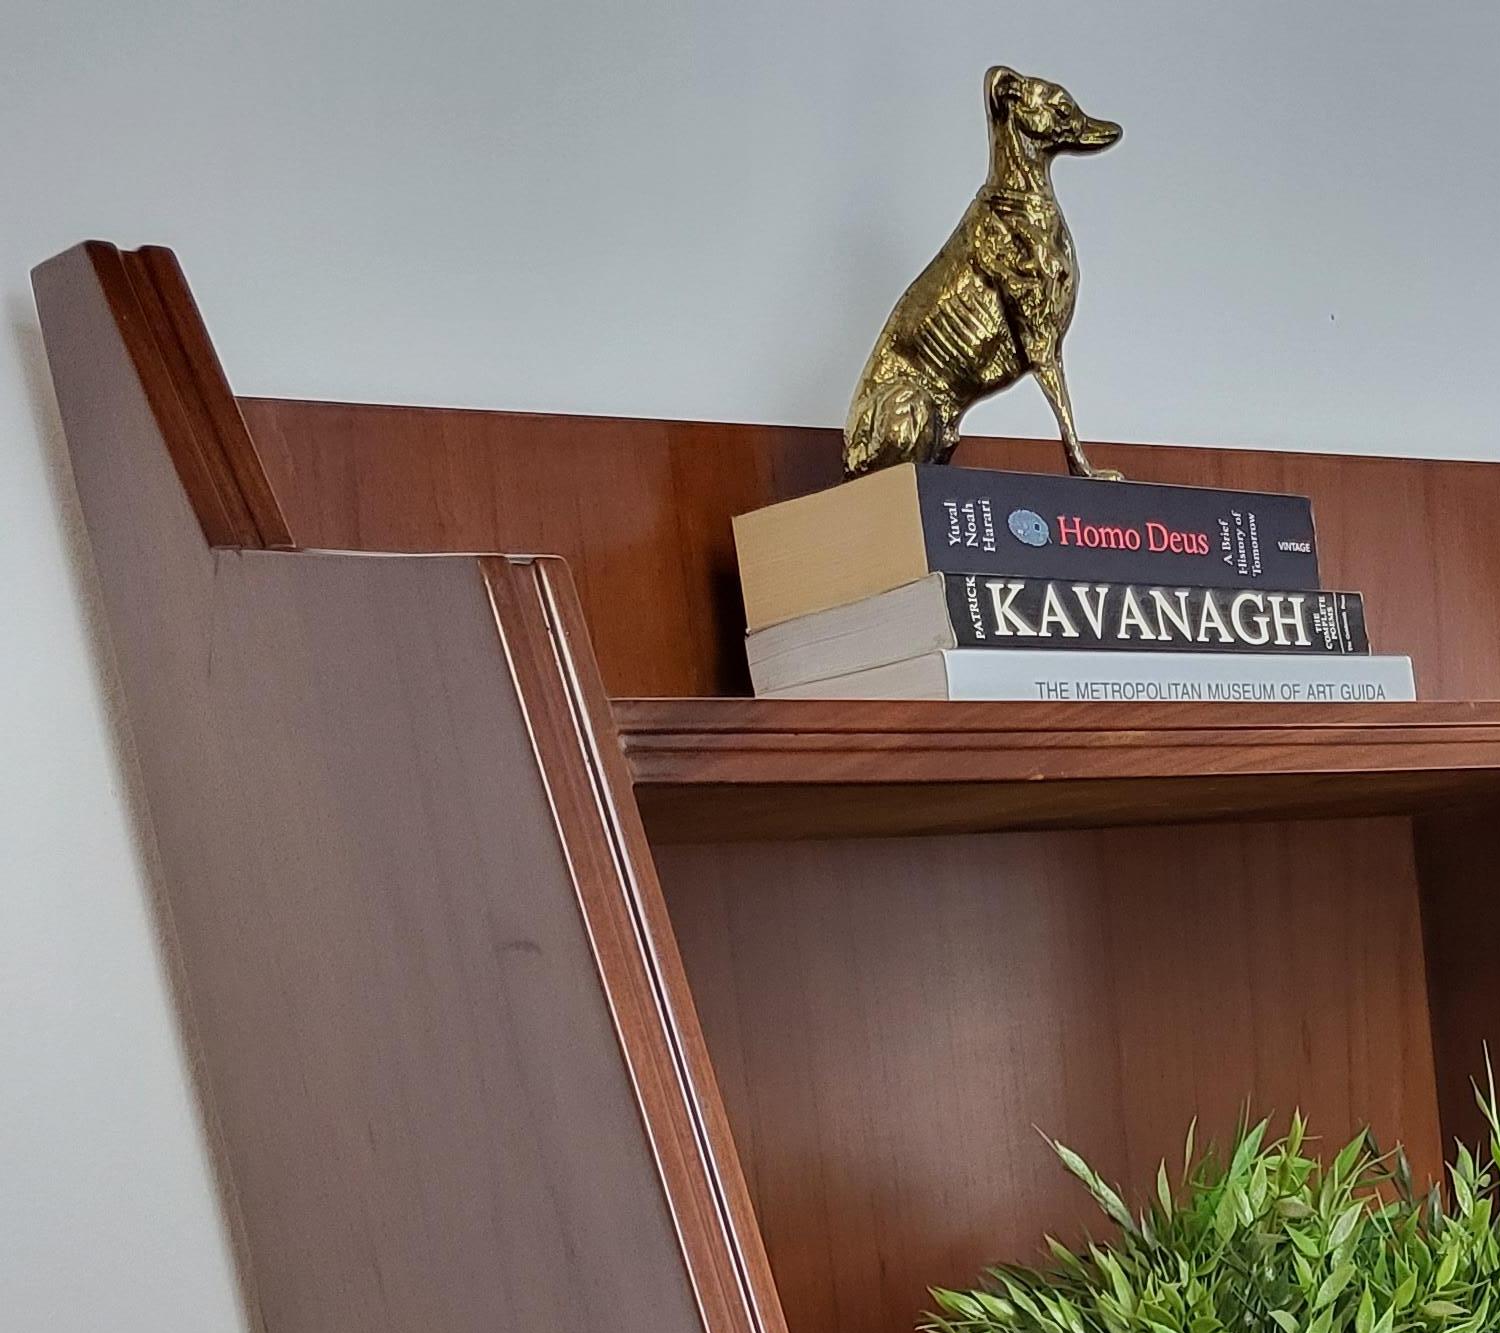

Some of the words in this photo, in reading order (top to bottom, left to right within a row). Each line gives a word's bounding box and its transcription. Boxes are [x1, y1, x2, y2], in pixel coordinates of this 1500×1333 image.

[943, 501, 961, 546] Yuval
[961, 503, 979, 547] Noah
[977, 499, 996, 552] Harari
[1056, 515, 1141, 551] Homo
[1146, 522, 1210, 555] Deus
[1218, 518, 1232, 551] Brief
[1231, 509, 1242, 526] of
[1223, 554, 1234, 566] A
[1236, 528, 1248, 575] History
[1247, 512, 1262, 577] Tomorrow
[1277, 541, 1312, 554] VINTAGE
[965, 575, 986, 640] PATRICK
[985, 583, 1312, 647] KAVANAGH
[1312, 612, 1322, 634] THE
[1318, 596, 1334, 650] COMPLETE
[1327, 606, 1338, 640] POEMS
[1034, 681, 1070, 700] THE
[1075, 682, 1201, 700] METROPOLITAN
[1207, 683, 1275, 700] MUSEUM
[1280, 683, 1301, 700] OF
[1306, 684, 1336, 700] ART
[1340, 684, 1386, 700] GUIDA
